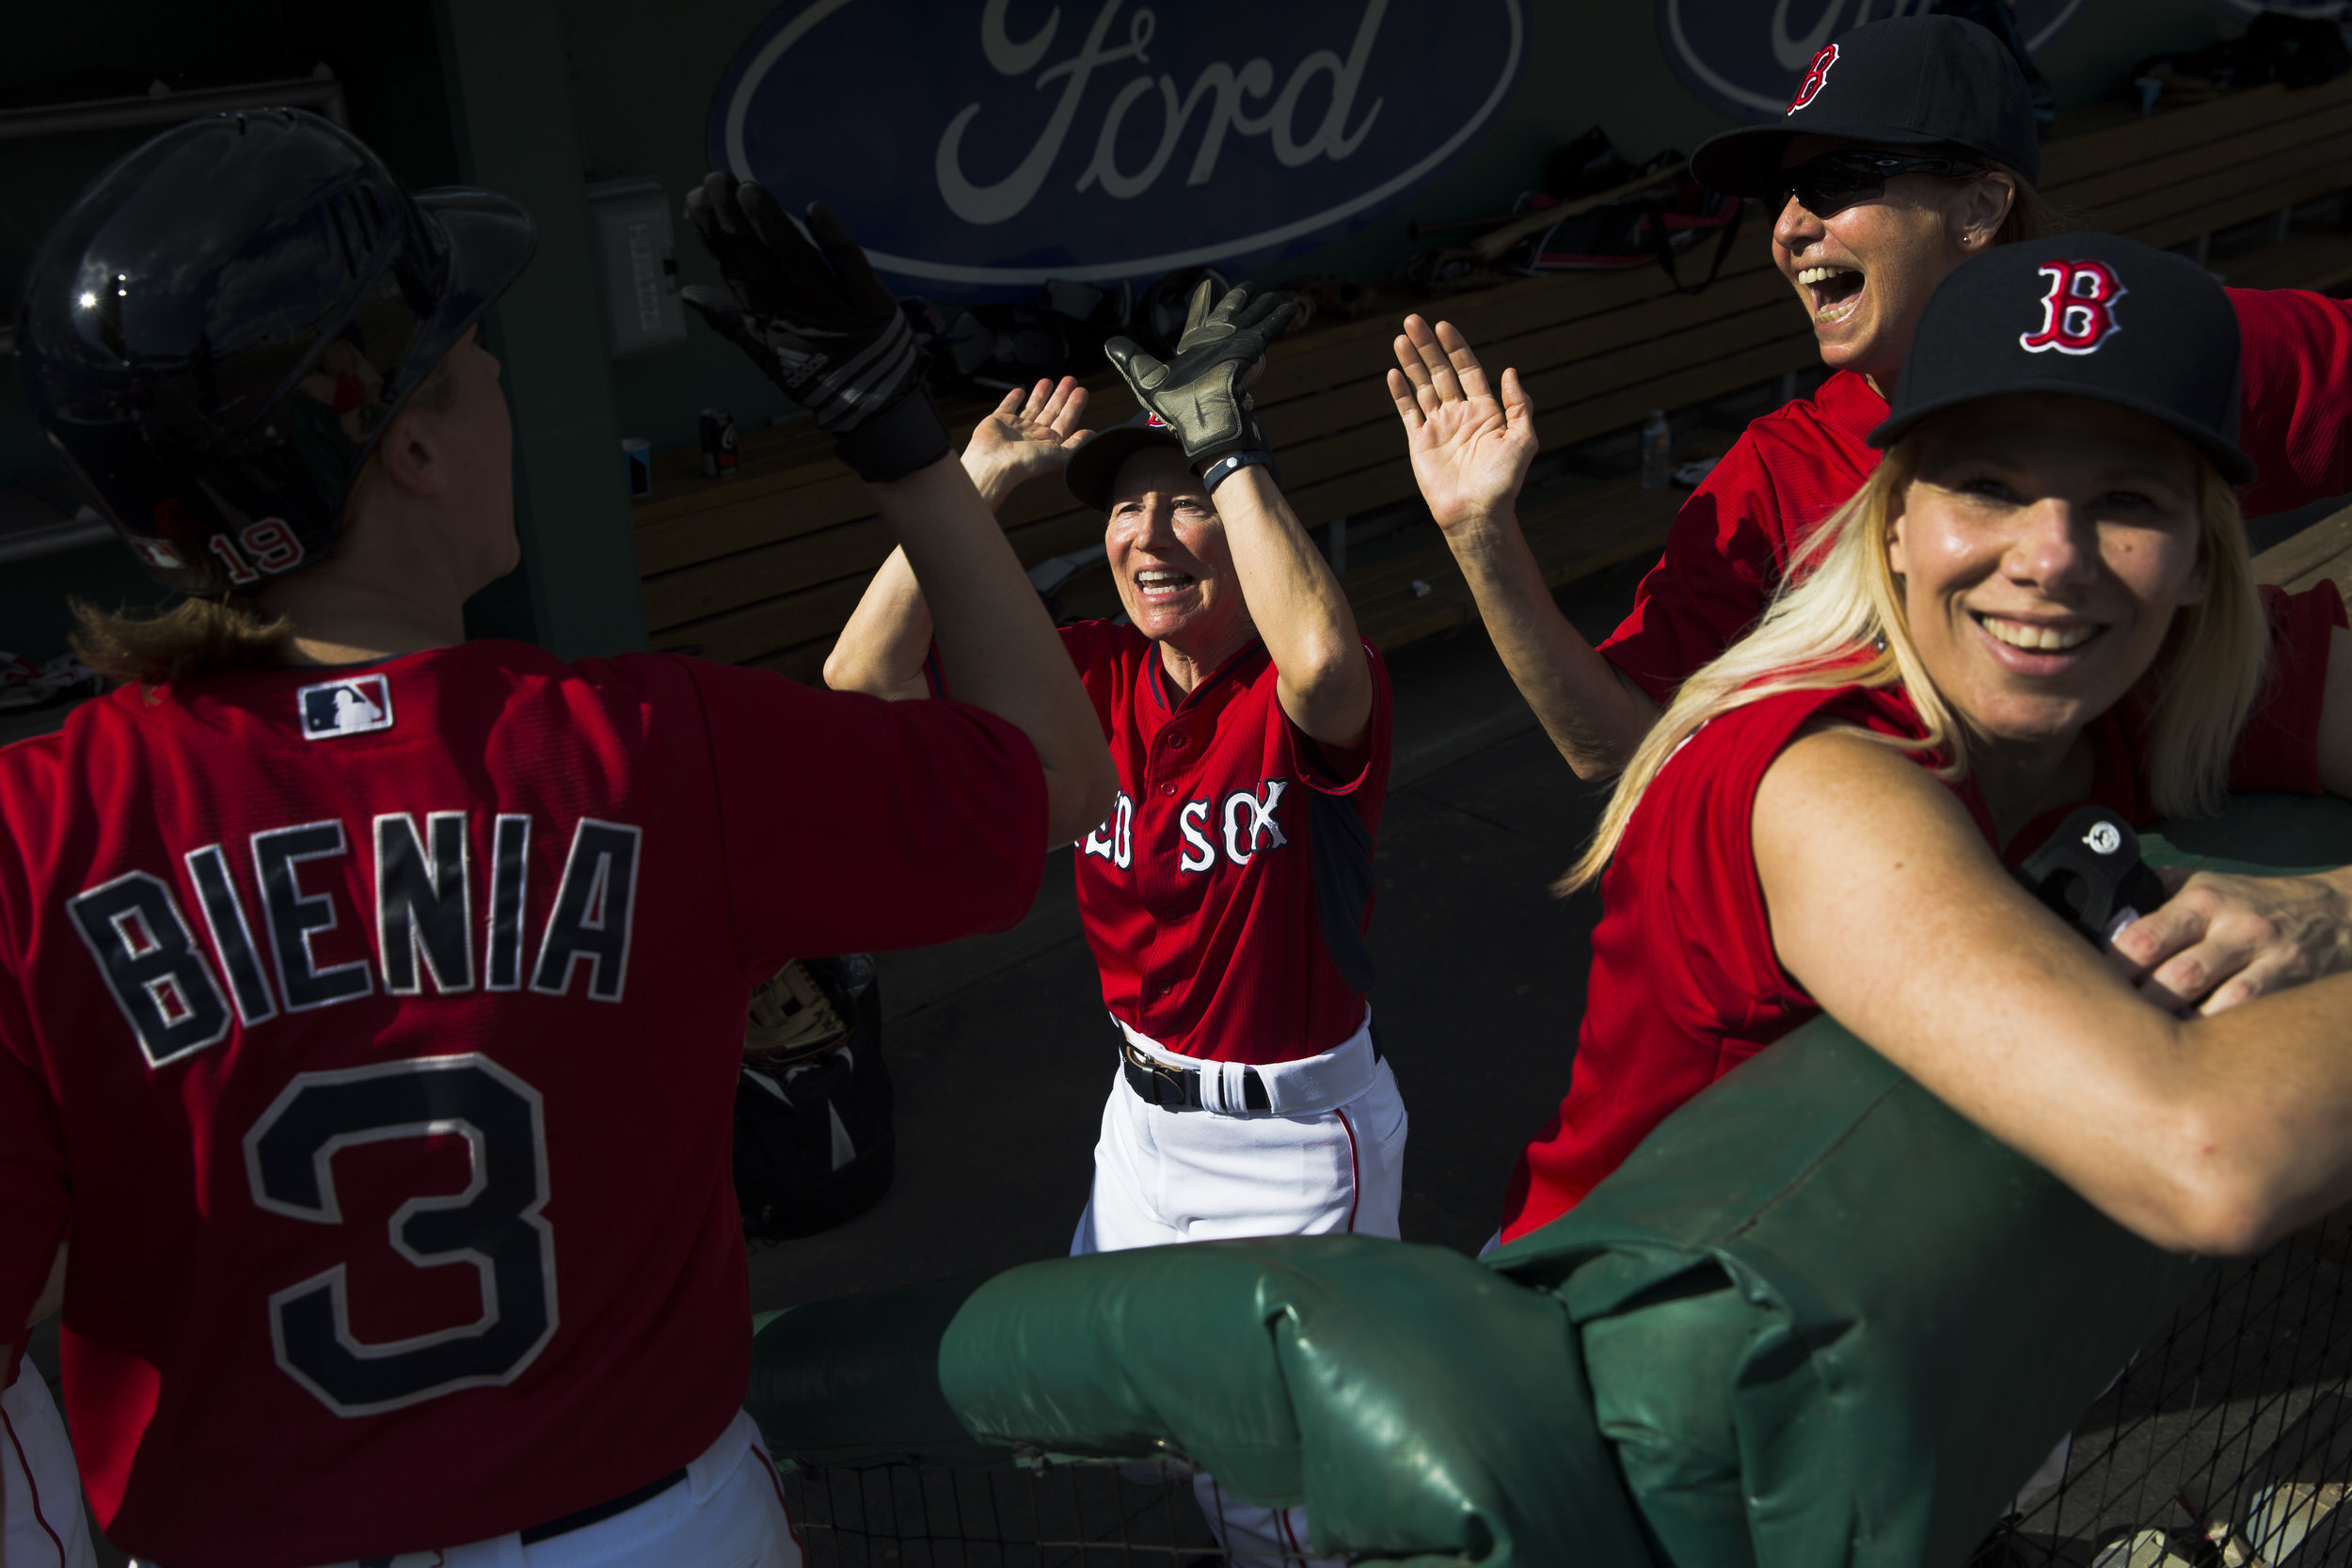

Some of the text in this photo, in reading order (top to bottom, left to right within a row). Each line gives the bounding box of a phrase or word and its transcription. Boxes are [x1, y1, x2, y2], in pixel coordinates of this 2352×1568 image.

[935, 0, 1383, 226] Ford
[1788, 42, 1840, 117] B
[2019, 259, 2129, 356] B
[209, 516, 306, 585] 19
[1074, 777, 1290, 876] ED SOX
[64, 809, 644, 1071] BIENIA
[241, 1051, 561, 1419] 3
